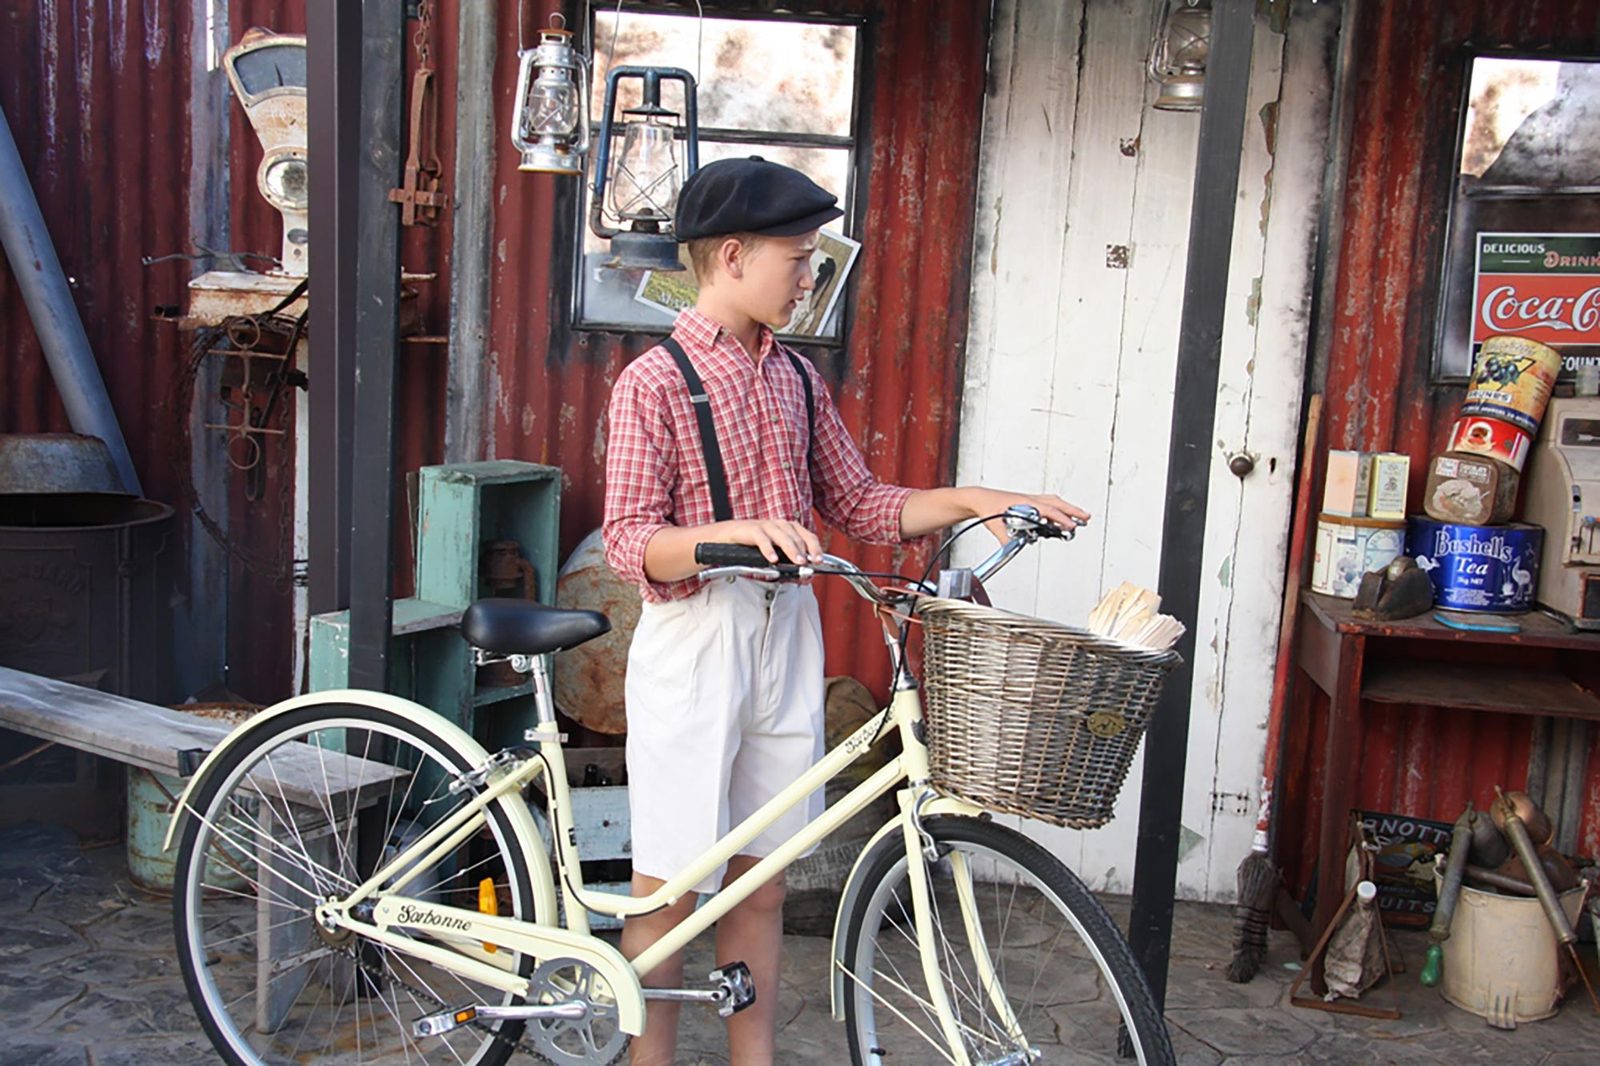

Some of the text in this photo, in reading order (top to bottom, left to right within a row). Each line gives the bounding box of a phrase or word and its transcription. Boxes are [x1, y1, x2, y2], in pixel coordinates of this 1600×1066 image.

[1482, 243, 1546, 254] DELICIOUS
[1481, 285, 1600, 332] Coca-C
[1434, 525, 1514, 563] Bushells
[1456, 556, 1489, 575] Tea
[397, 904, 472, 931] Sorbonne
